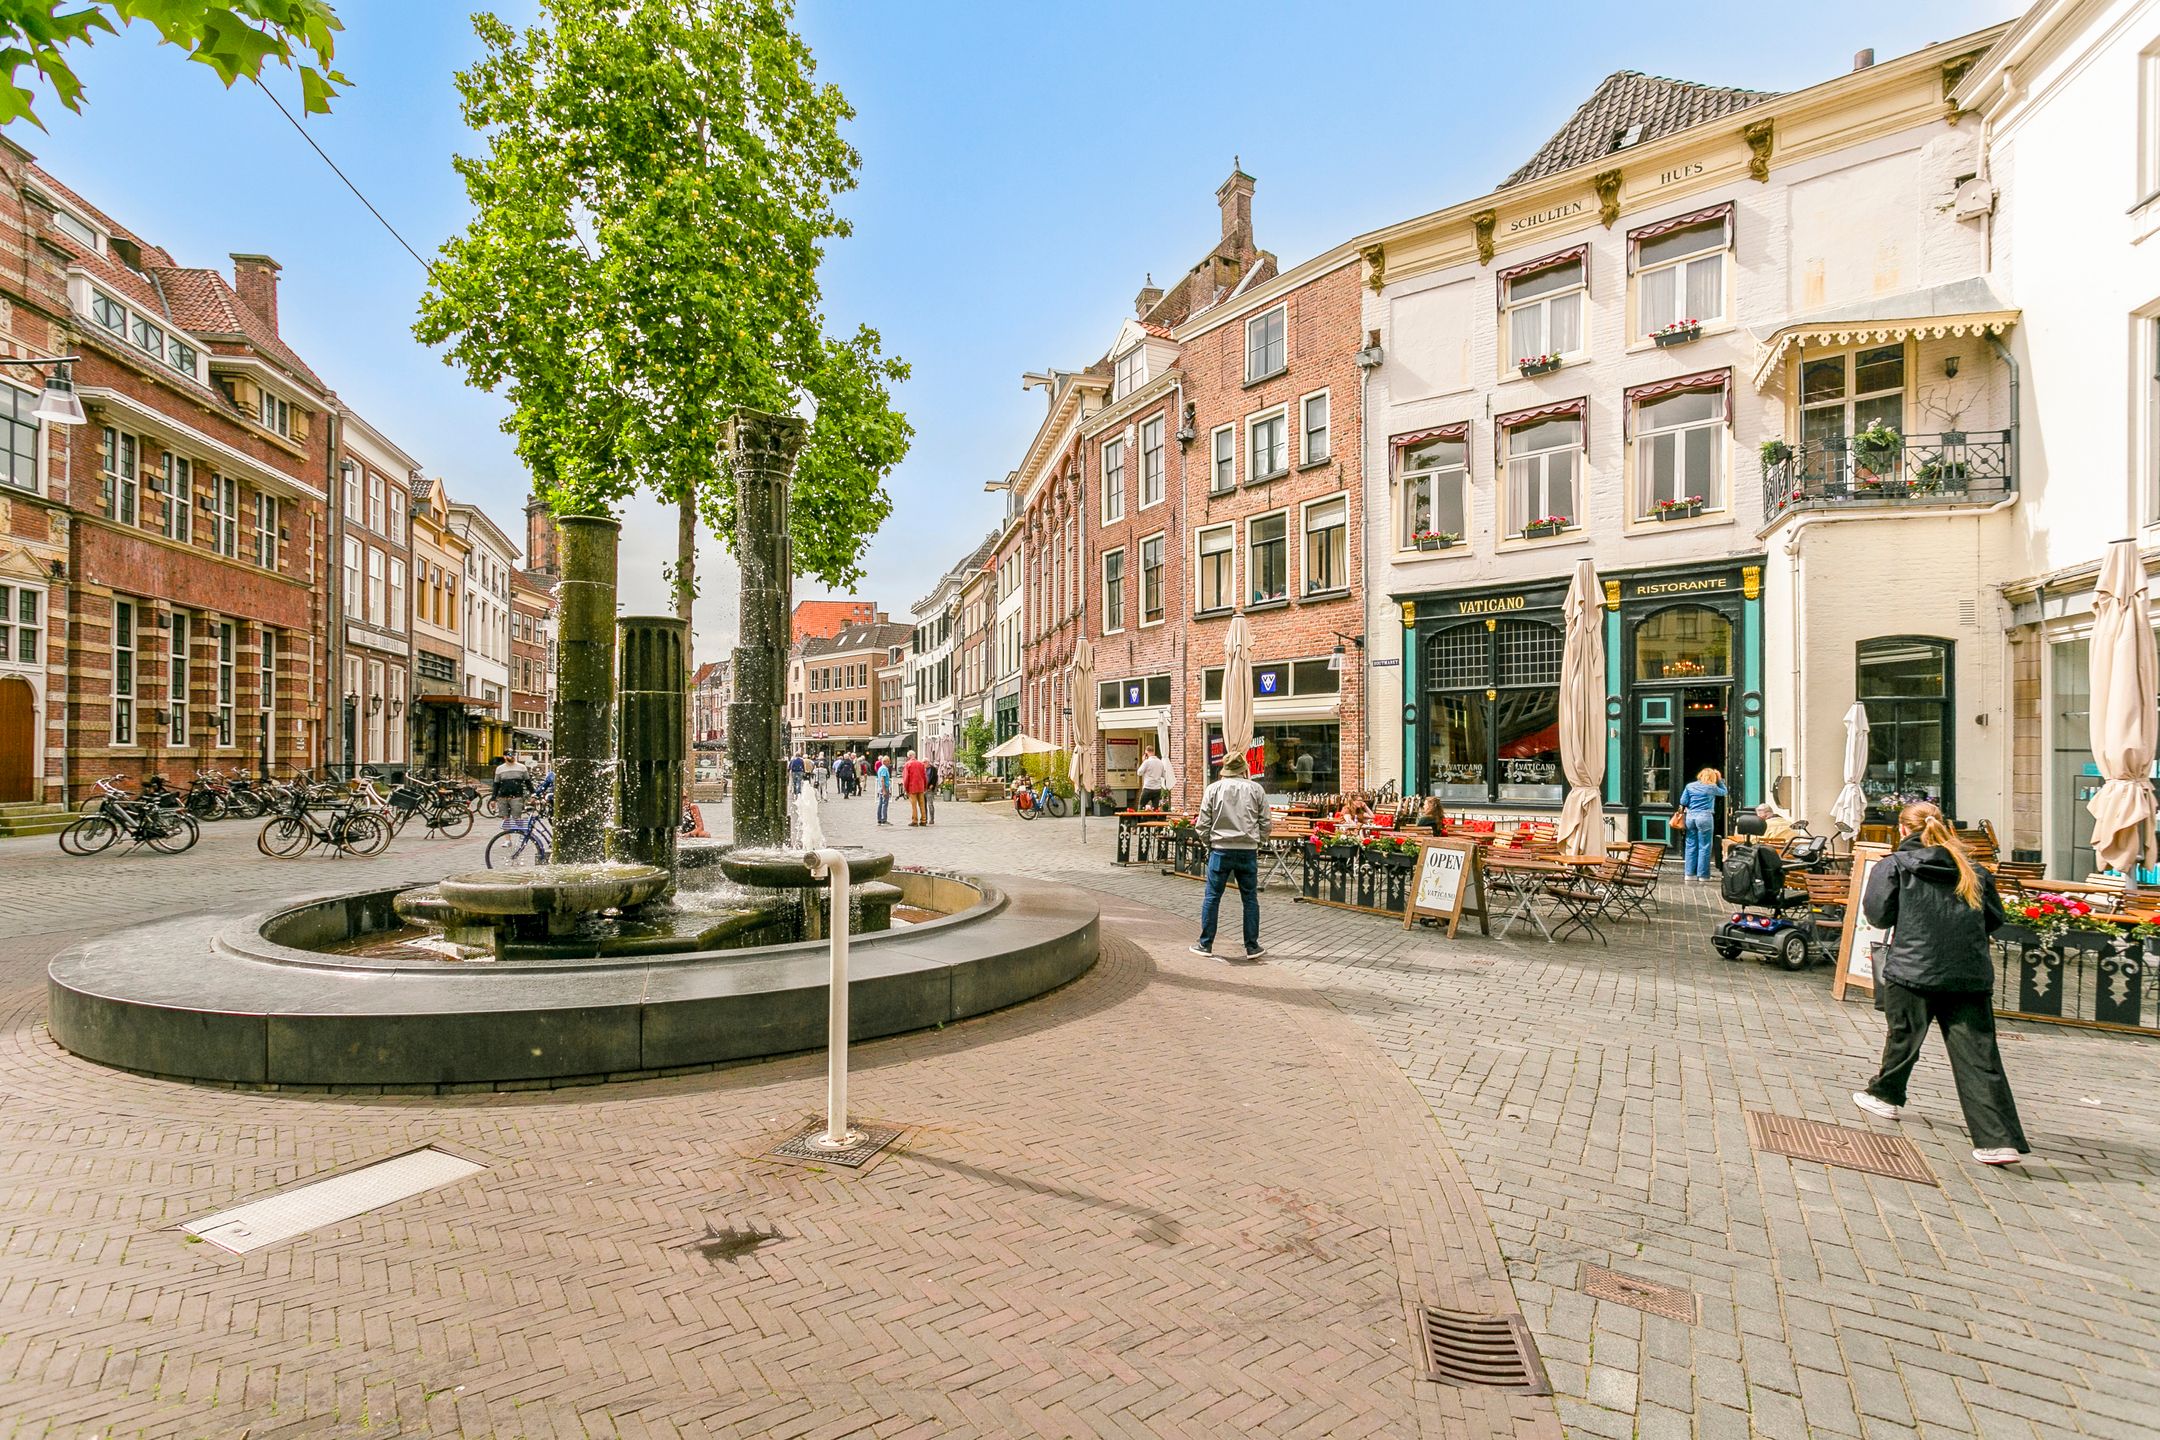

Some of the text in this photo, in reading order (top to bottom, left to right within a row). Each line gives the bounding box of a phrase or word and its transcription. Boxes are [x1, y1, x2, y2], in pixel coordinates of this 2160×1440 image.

[1511, 201, 1582, 231] SCHULTEN
[1637, 578, 1727, 595] RISTORANTE
[1459, 596, 1525, 614] VATICANO
[1448, 763, 1483, 772] VATICANO
[1518, 763, 1556, 771] VATICANO
[1429, 852, 1463, 870] OPEN
[1427, 889, 1456, 899] VATICANO
